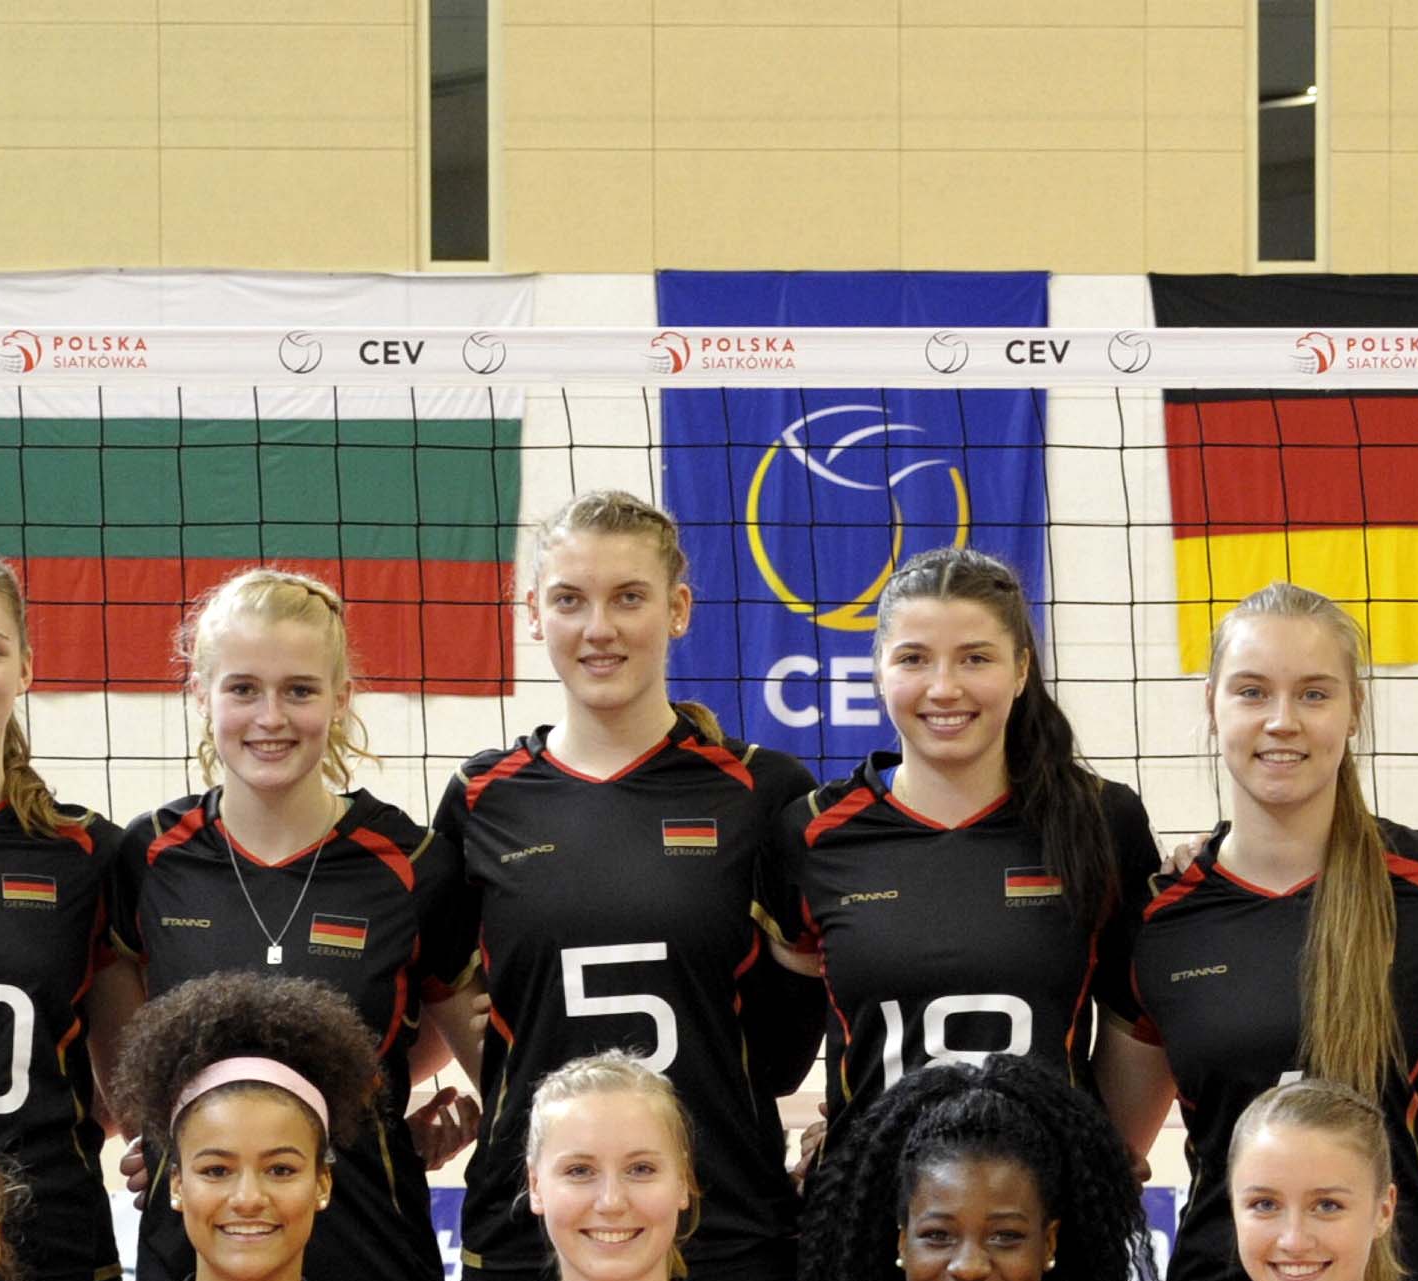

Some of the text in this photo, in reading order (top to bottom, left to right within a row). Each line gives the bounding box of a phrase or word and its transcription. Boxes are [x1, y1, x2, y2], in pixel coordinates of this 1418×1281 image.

[53, 335, 148, 352] POLSKA
[701, 336, 796, 353] POLSKA
[1005, 340, 1070, 364] CEV
[53, 352, 148, 369] SIATKÓWKA
[359, 341, 424, 365] CEV
[701, 353, 796, 370] SIATKÓWKA
[764, 655, 880, 728] CE
[664, 847, 718, 857] GERMANY
[841, 890, 899, 906] STANNO
[161, 916, 210, 929] STANNO
[307, 945, 361, 961] GERMANY
[1171, 965, 1227, 982] STANNO
[562, 942, 679, 1076] 5
